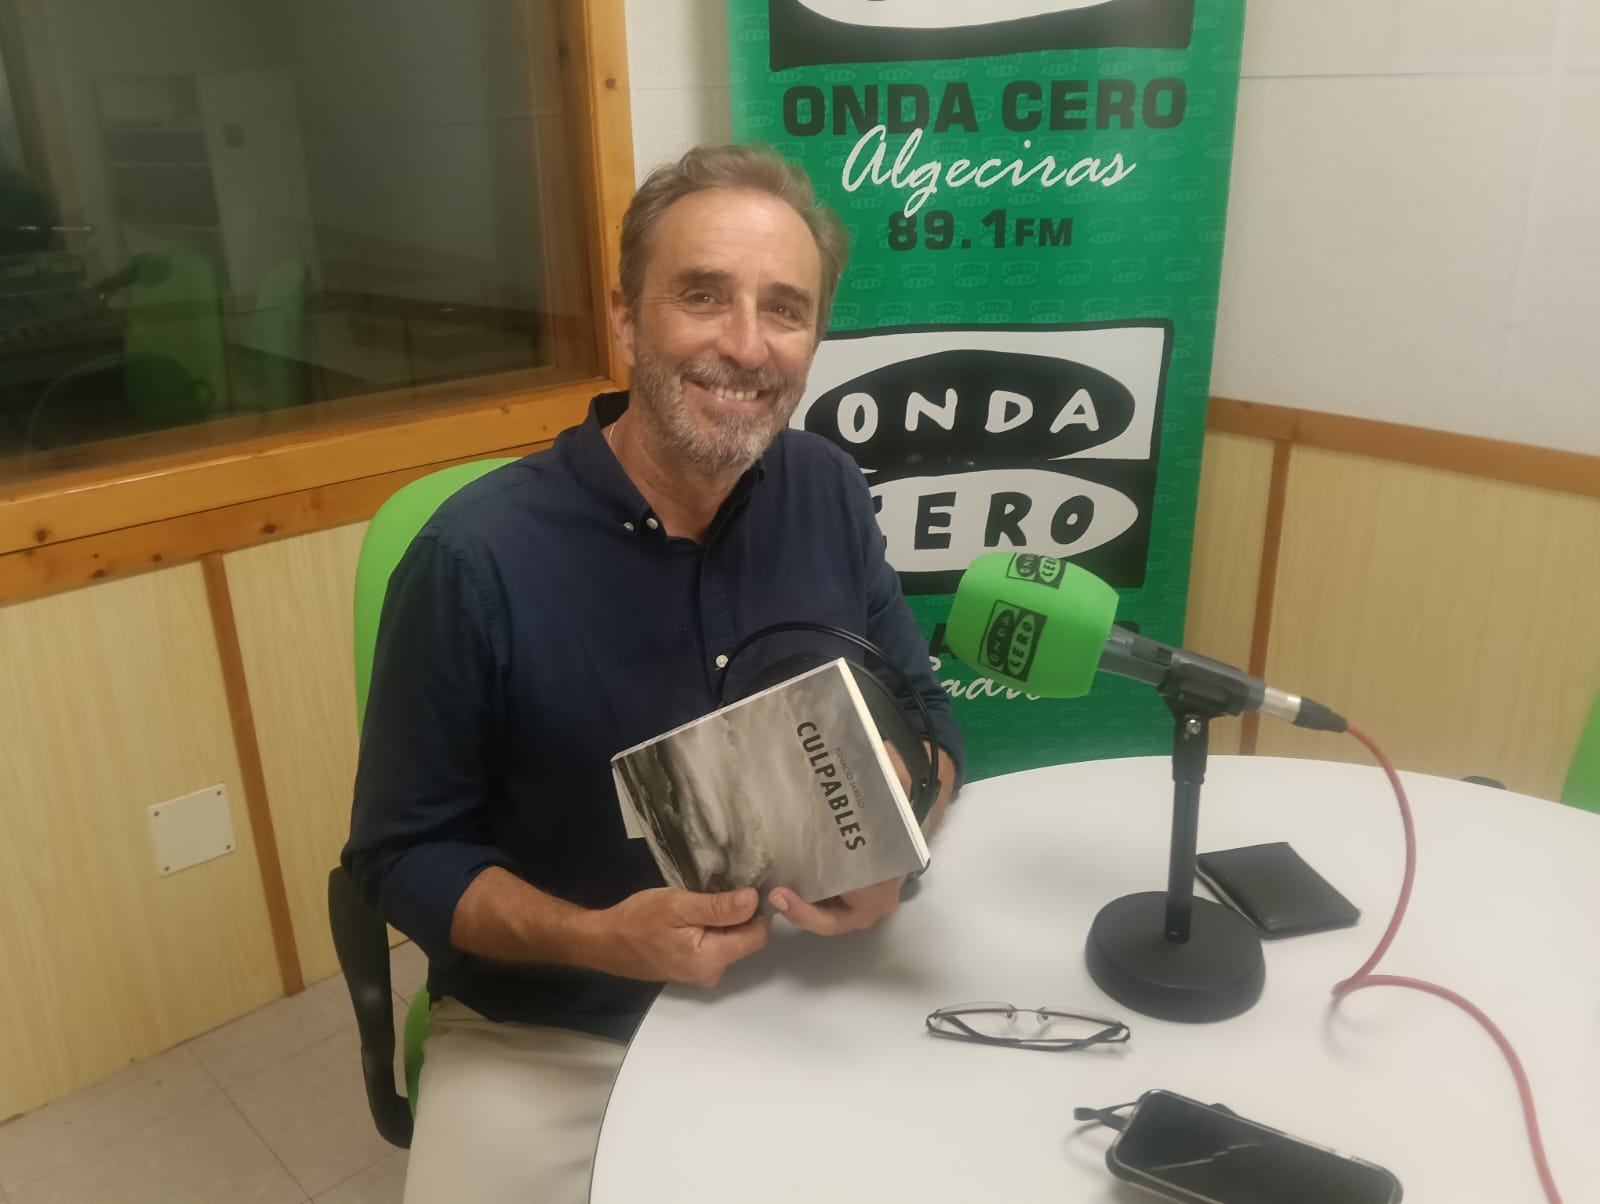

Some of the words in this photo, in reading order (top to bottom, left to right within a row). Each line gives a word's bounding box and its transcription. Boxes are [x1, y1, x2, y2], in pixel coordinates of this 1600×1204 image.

[782, 82, 979, 137] ONDA
[1001, 77, 1187, 133] CERO
[842, 124, 1137, 218] Algeciras
[837, 388, 1100, 444] ONDA
[872, 491, 1095, 560] ERO
[989, 616, 1011, 662] ONDA
[1010, 621, 1032, 668] CERO
[796, 721, 866, 851] CULPABLES
